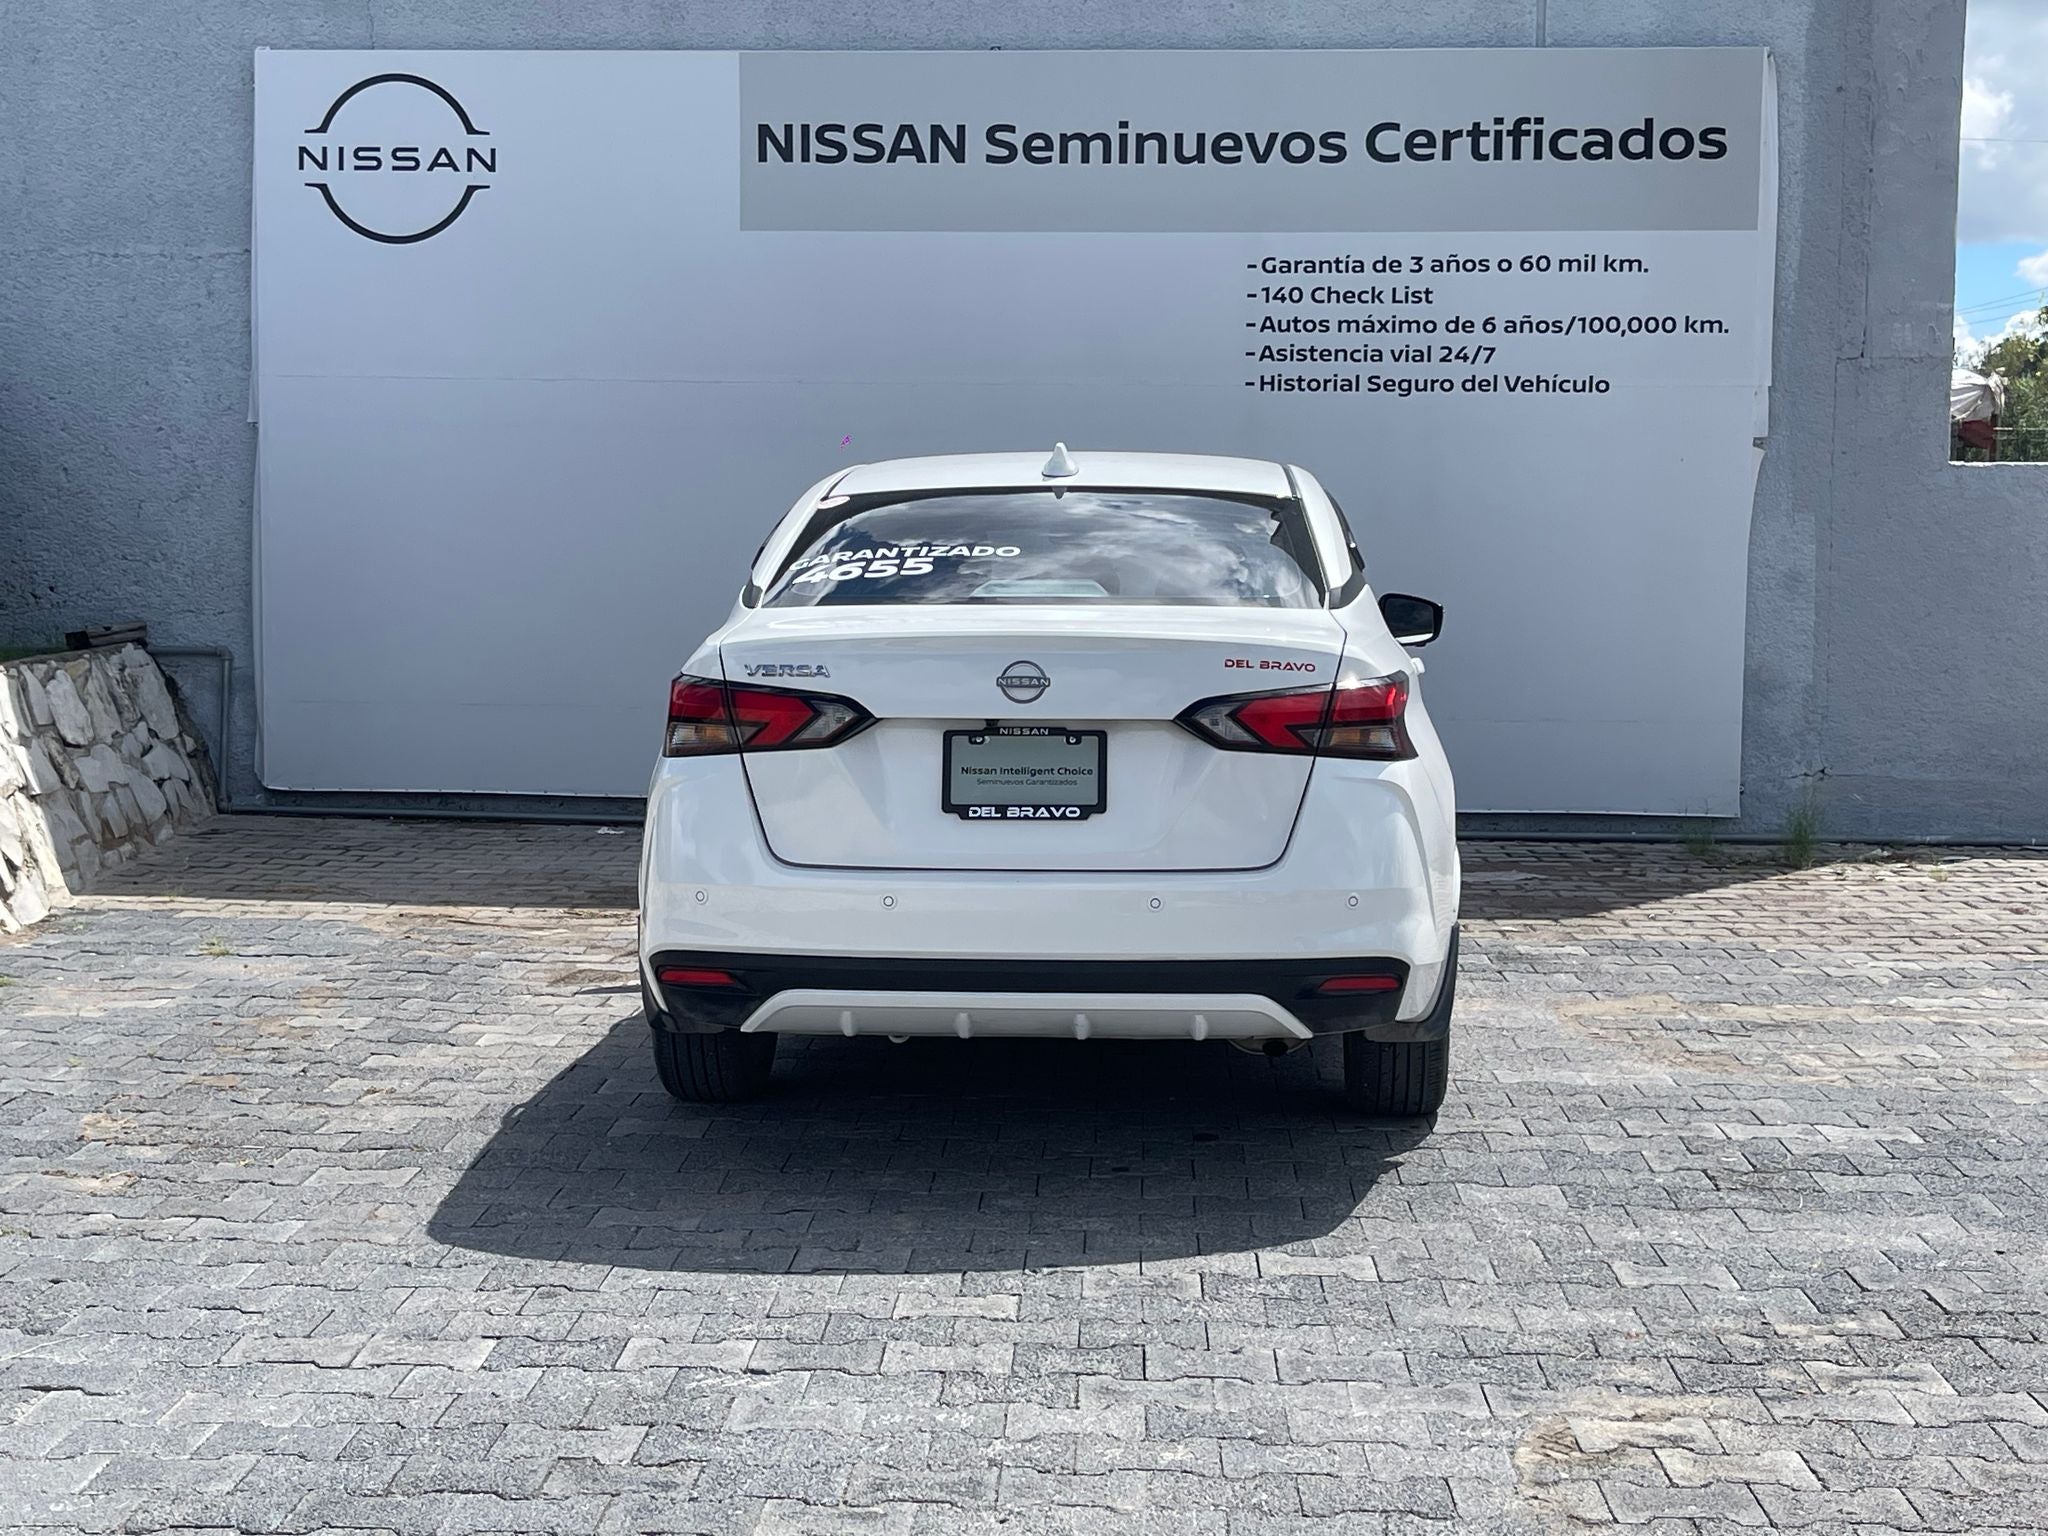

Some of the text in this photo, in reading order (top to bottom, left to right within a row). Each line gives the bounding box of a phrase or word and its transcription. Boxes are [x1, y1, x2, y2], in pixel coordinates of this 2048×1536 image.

[757, 116, 1728, 165] NISSAN Seminuevos Certificados
[298, 145, 497, 173] NISSAN
[1246, 253, 1649, 274] -Garantía de 3 años o 60 mil km.
[1246, 285, 1434, 305] -140 Check List
[1245, 314, 1729, 338] -Autos máximo de 6 años/100,000 km.
[1245, 343, 1497, 365] -Asistencia vial 24/7
[1244, 373, 1610, 398] -Historial Seguro del Vehículo
[789, 546, 1021, 571] GARANTIZADO
[792, 557, 934, 585] 4655
[744, 664, 831, 678] VERSA
[1224, 659, 1316, 673] DEL BRAVO
[998, 677, 1050, 687] NISSAN
[999, 727, 1049, 736] NISSAN
[960, 766, 1094, 778] Nissan Intelligent Choice
[976, 777, 1078, 786] Seminuevos Garantizados
[968, 806, 1081, 818] DEL BRAVO
